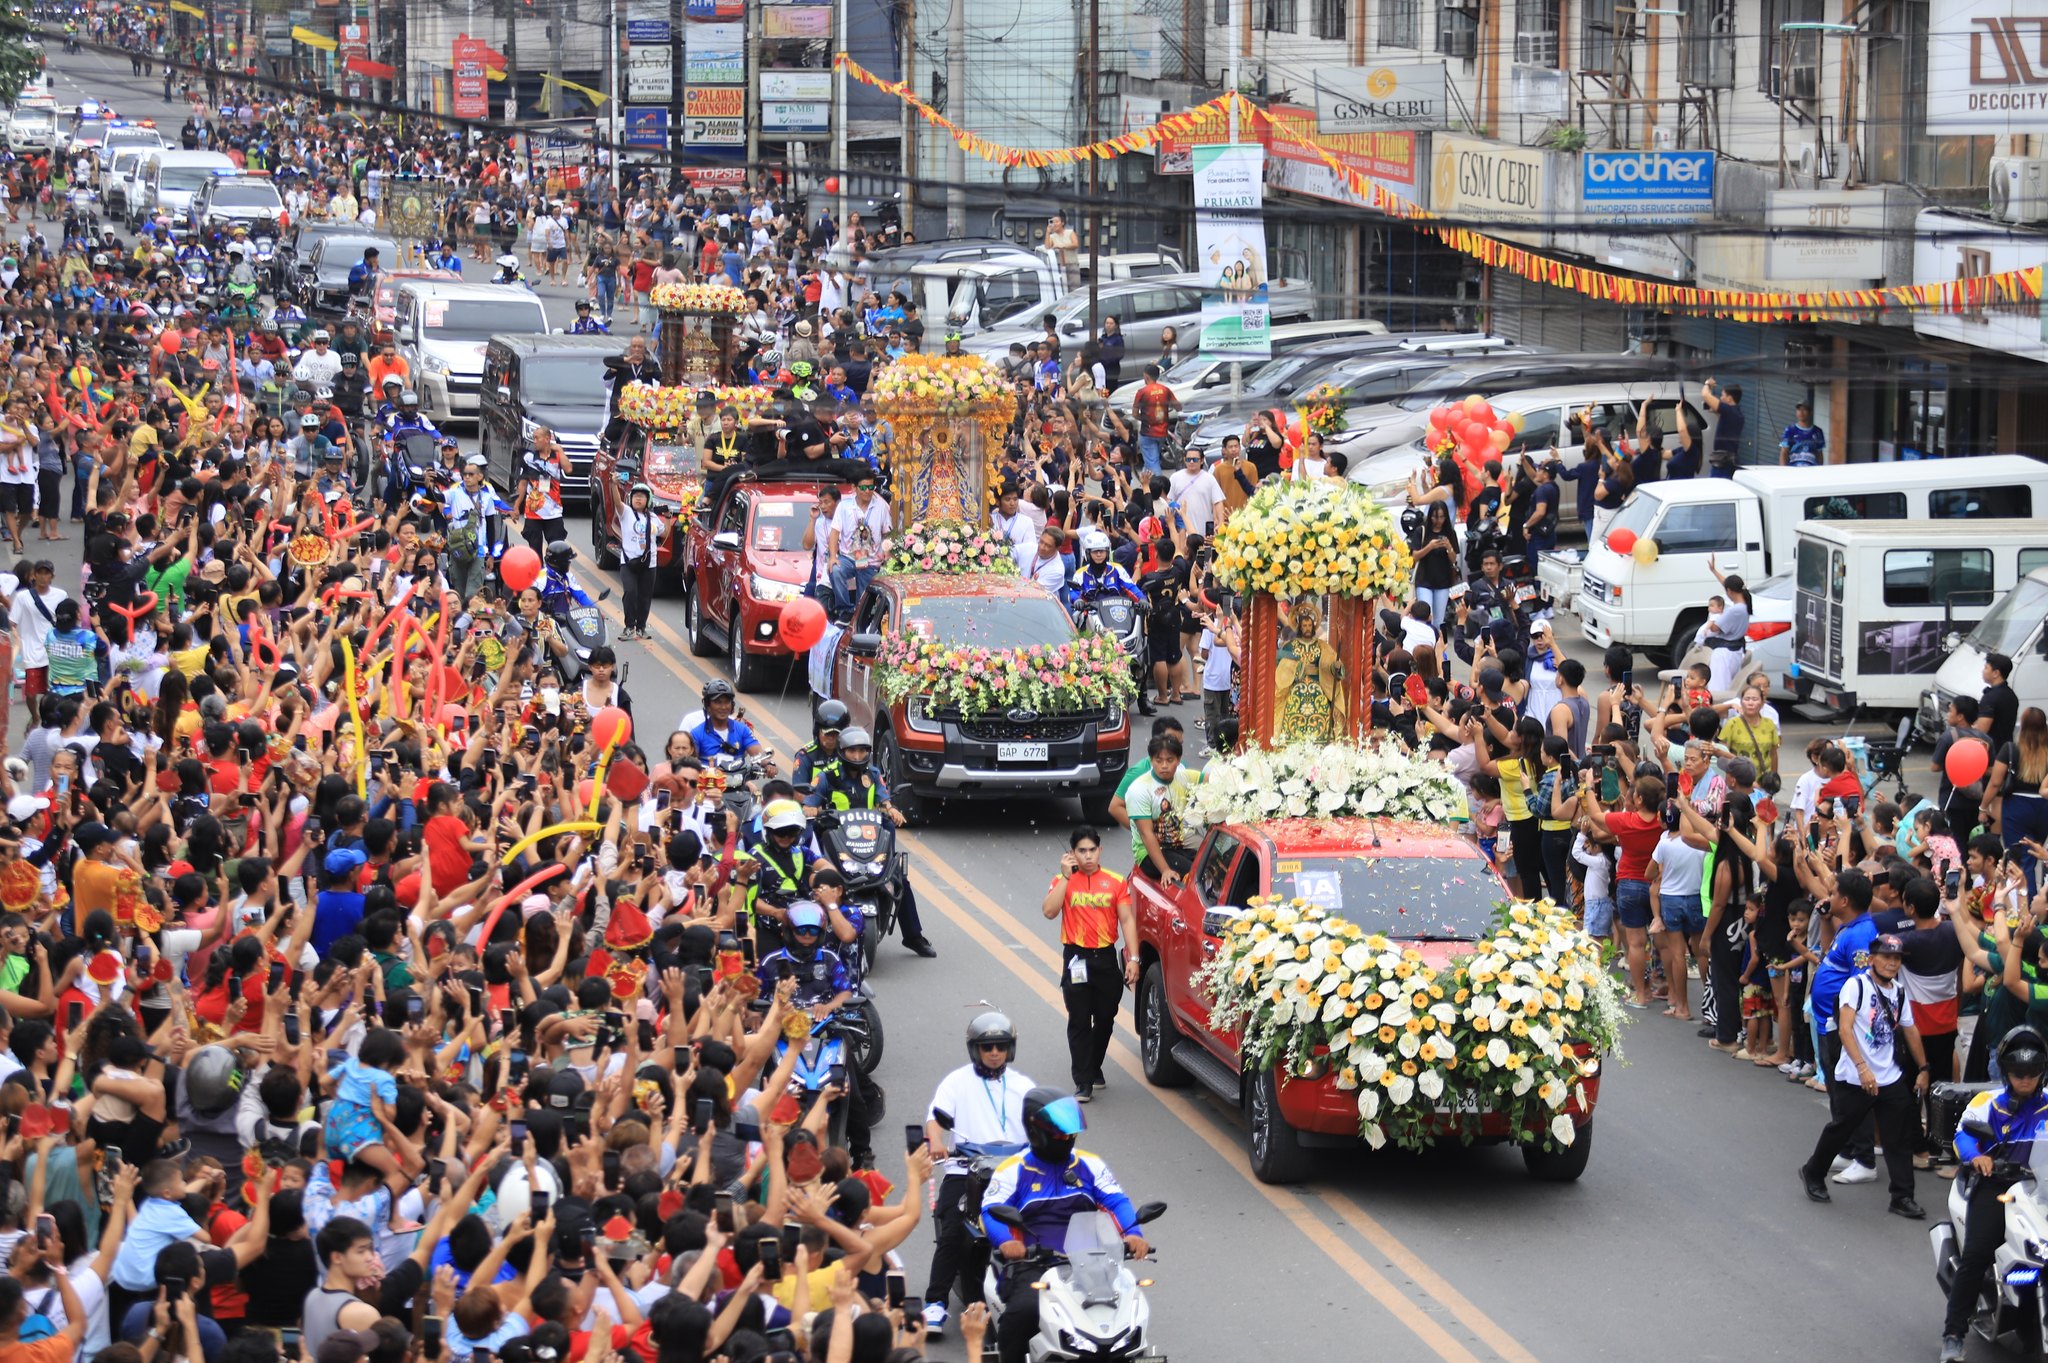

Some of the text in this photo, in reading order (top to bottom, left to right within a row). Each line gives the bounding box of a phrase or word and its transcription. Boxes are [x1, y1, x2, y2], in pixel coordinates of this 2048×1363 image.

[697, 90, 741, 102] PALAWAN
[1969, 93, 2047, 110] DECOCITY
[687, 103, 741, 115] PAWNSHOP
[788, 104, 815, 113] KMBI
[1334, 100, 1432, 119] GSM CEBU
[1349, 133, 1373, 156] STEEL
[1375, 132, 1409, 164] TRADING
[1588, 154, 1705, 182] brother
[1458, 151, 1540, 210] GSM CEBU
[1203, 196, 1254, 207] PRIMARY
[1584, 204, 1712, 214] AUTHORIZED SERVICE CENTRE
[1800, 248, 1858, 256] LAW OFFICES
[1206, 340, 1264, 348] primaryhomes.com
[655, 455, 667, 465] 4
[763, 529, 776, 542] 3
[49, 643, 84, 658] MEDIA
[999, 746, 1047, 757] GAP 6778
[840, 812, 882, 826] POLICE
[1299, 879, 1337, 896] 1A
